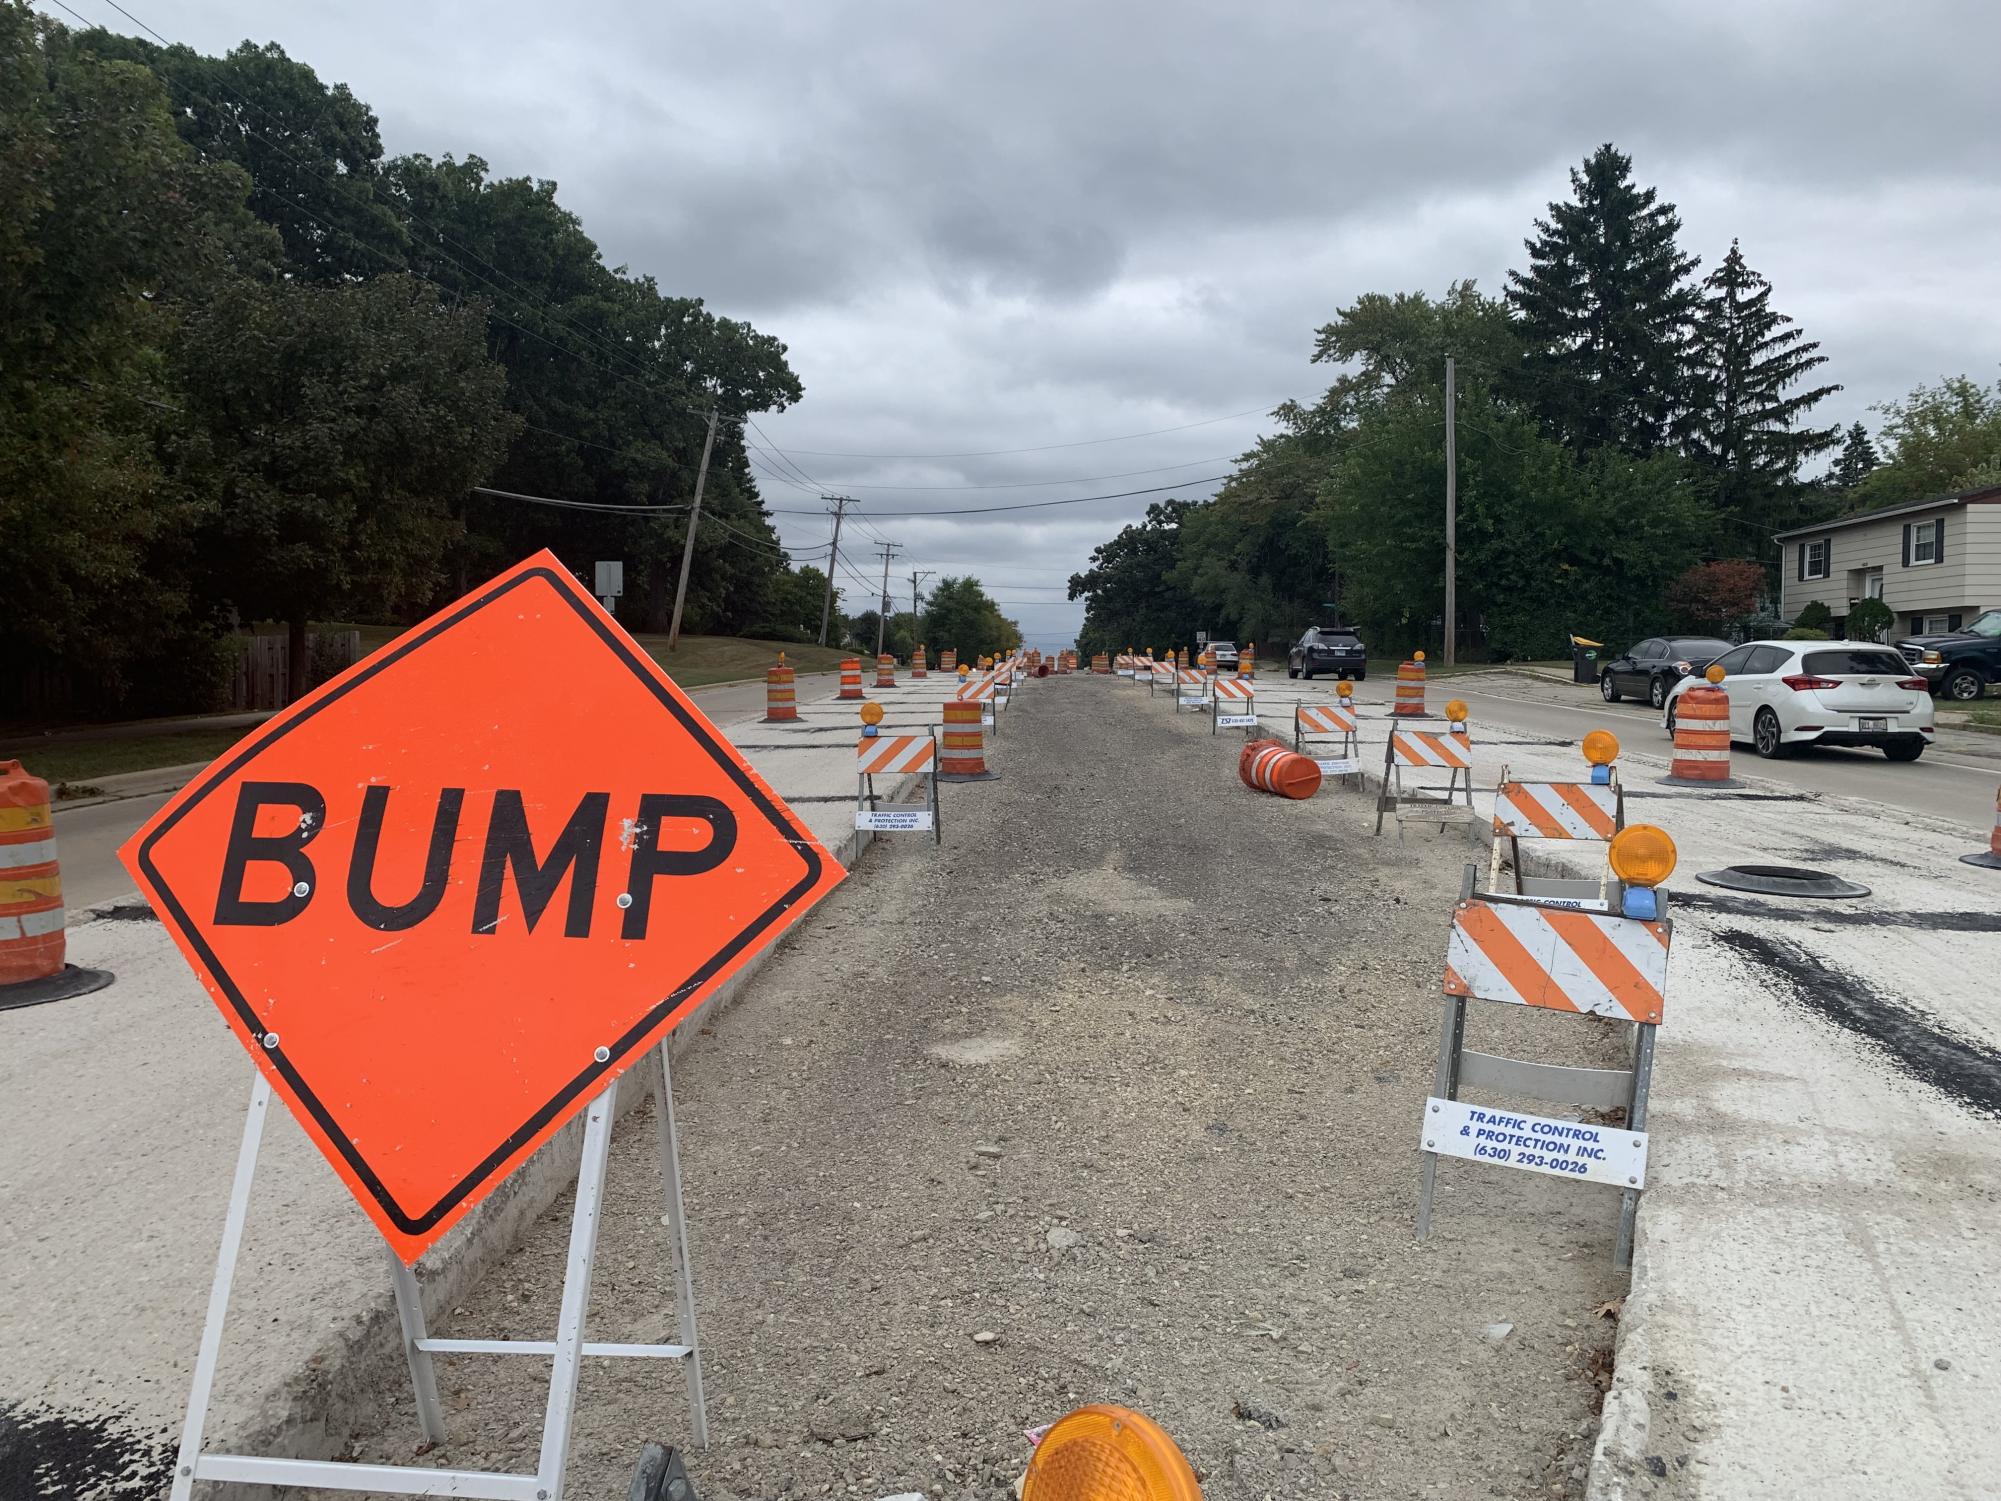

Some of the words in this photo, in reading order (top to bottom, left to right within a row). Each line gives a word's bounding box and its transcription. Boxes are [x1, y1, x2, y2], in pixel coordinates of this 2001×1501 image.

[213, 780, 739, 941] BUMP
[1459, 1125, 1471, 1137] &
[1475, 1128, 1571, 1155] PROTECTION
[1576, 1145, 1607, 1161] INC.
[1469, 1110, 1527, 1131] TRAFFIC
[1531, 1122, 1600, 1143] CONTROL
[1474, 1143, 1512, 1162] (630)
[1516, 1151, 1588, 1175] 293-0026
